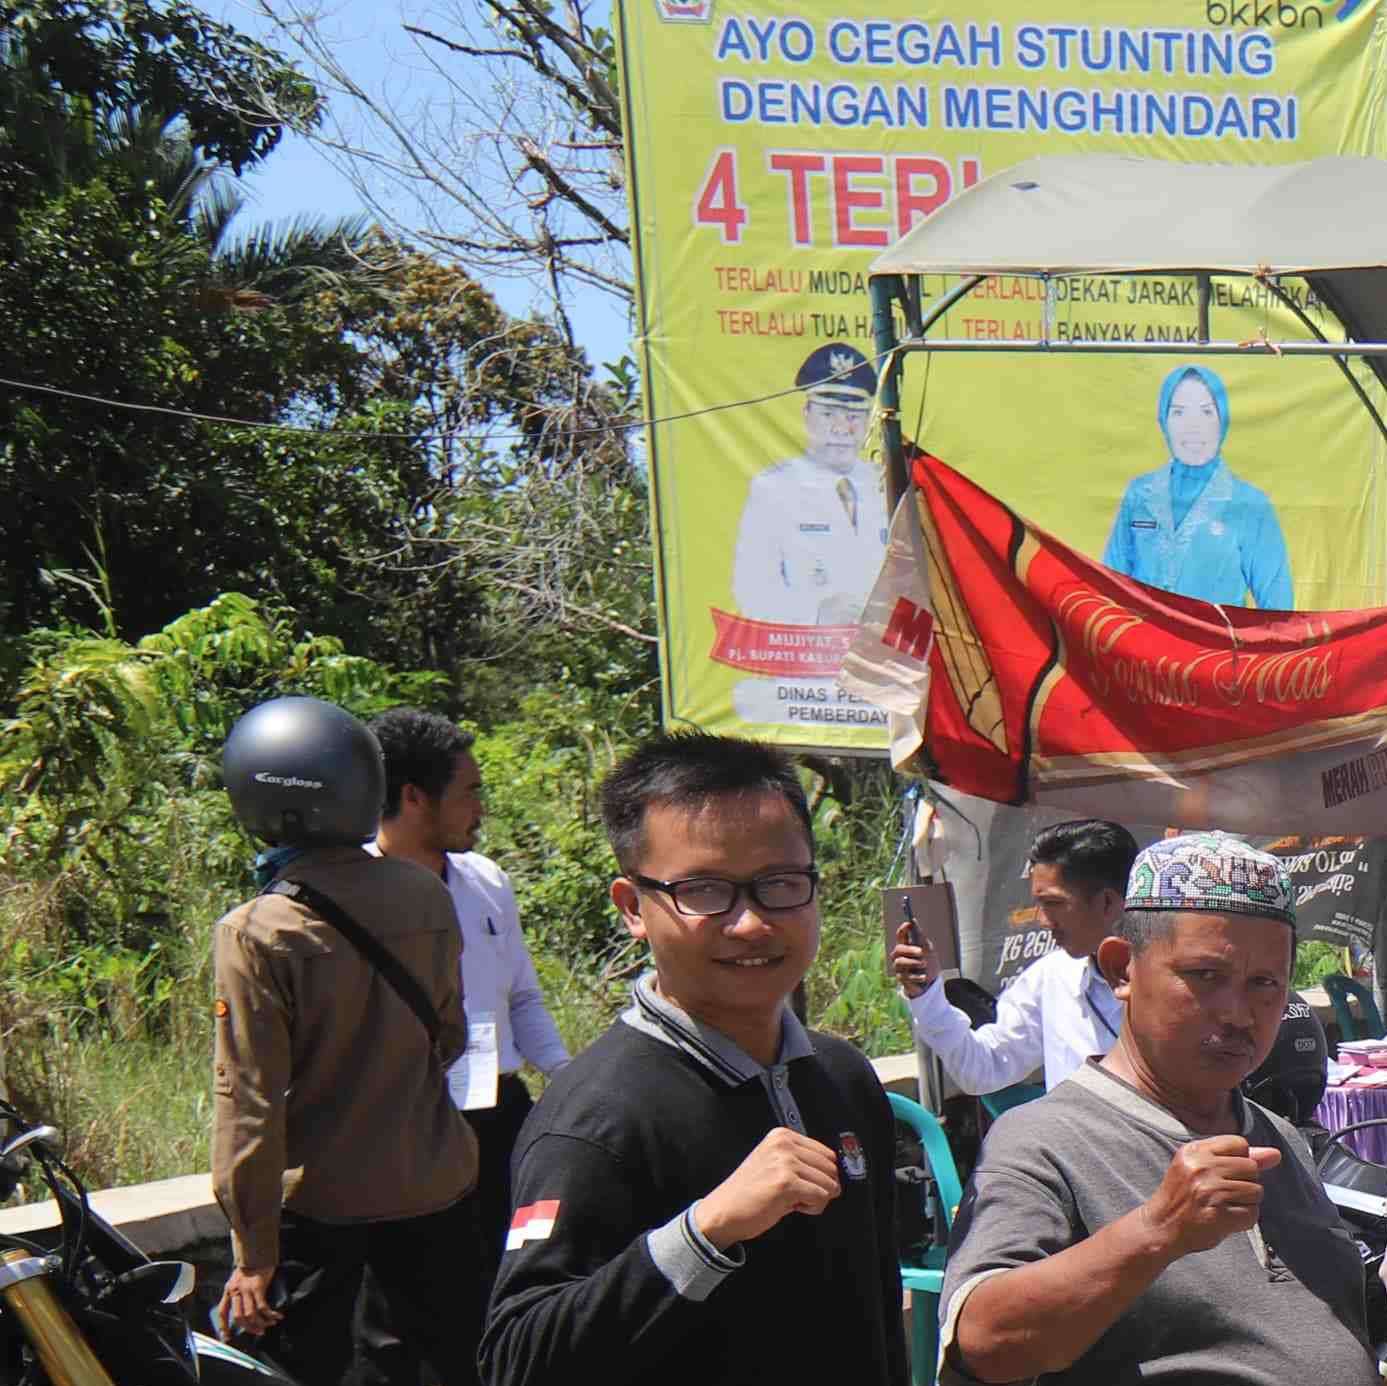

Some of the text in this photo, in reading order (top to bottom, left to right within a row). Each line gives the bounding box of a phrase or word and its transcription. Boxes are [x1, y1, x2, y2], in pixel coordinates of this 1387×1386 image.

[717, 18, 1274, 75] AYO CEGAH STUNTING
[721, 80, 1296, 139] DENGAN MENGHINDARI
[697, 151, 978, 247] 4 TER
[714, 267, 867, 296] TERLALU MUDA
[968, 276, 1048, 301] ERLALU
[1056, 277, 1121, 303] DEKAT
[1127, 281, 1196, 305] JARAK
[718, 310, 806, 338] TERLALU
[811, 313, 850, 338] TUA
[778, 686, 827, 702] DINAS
